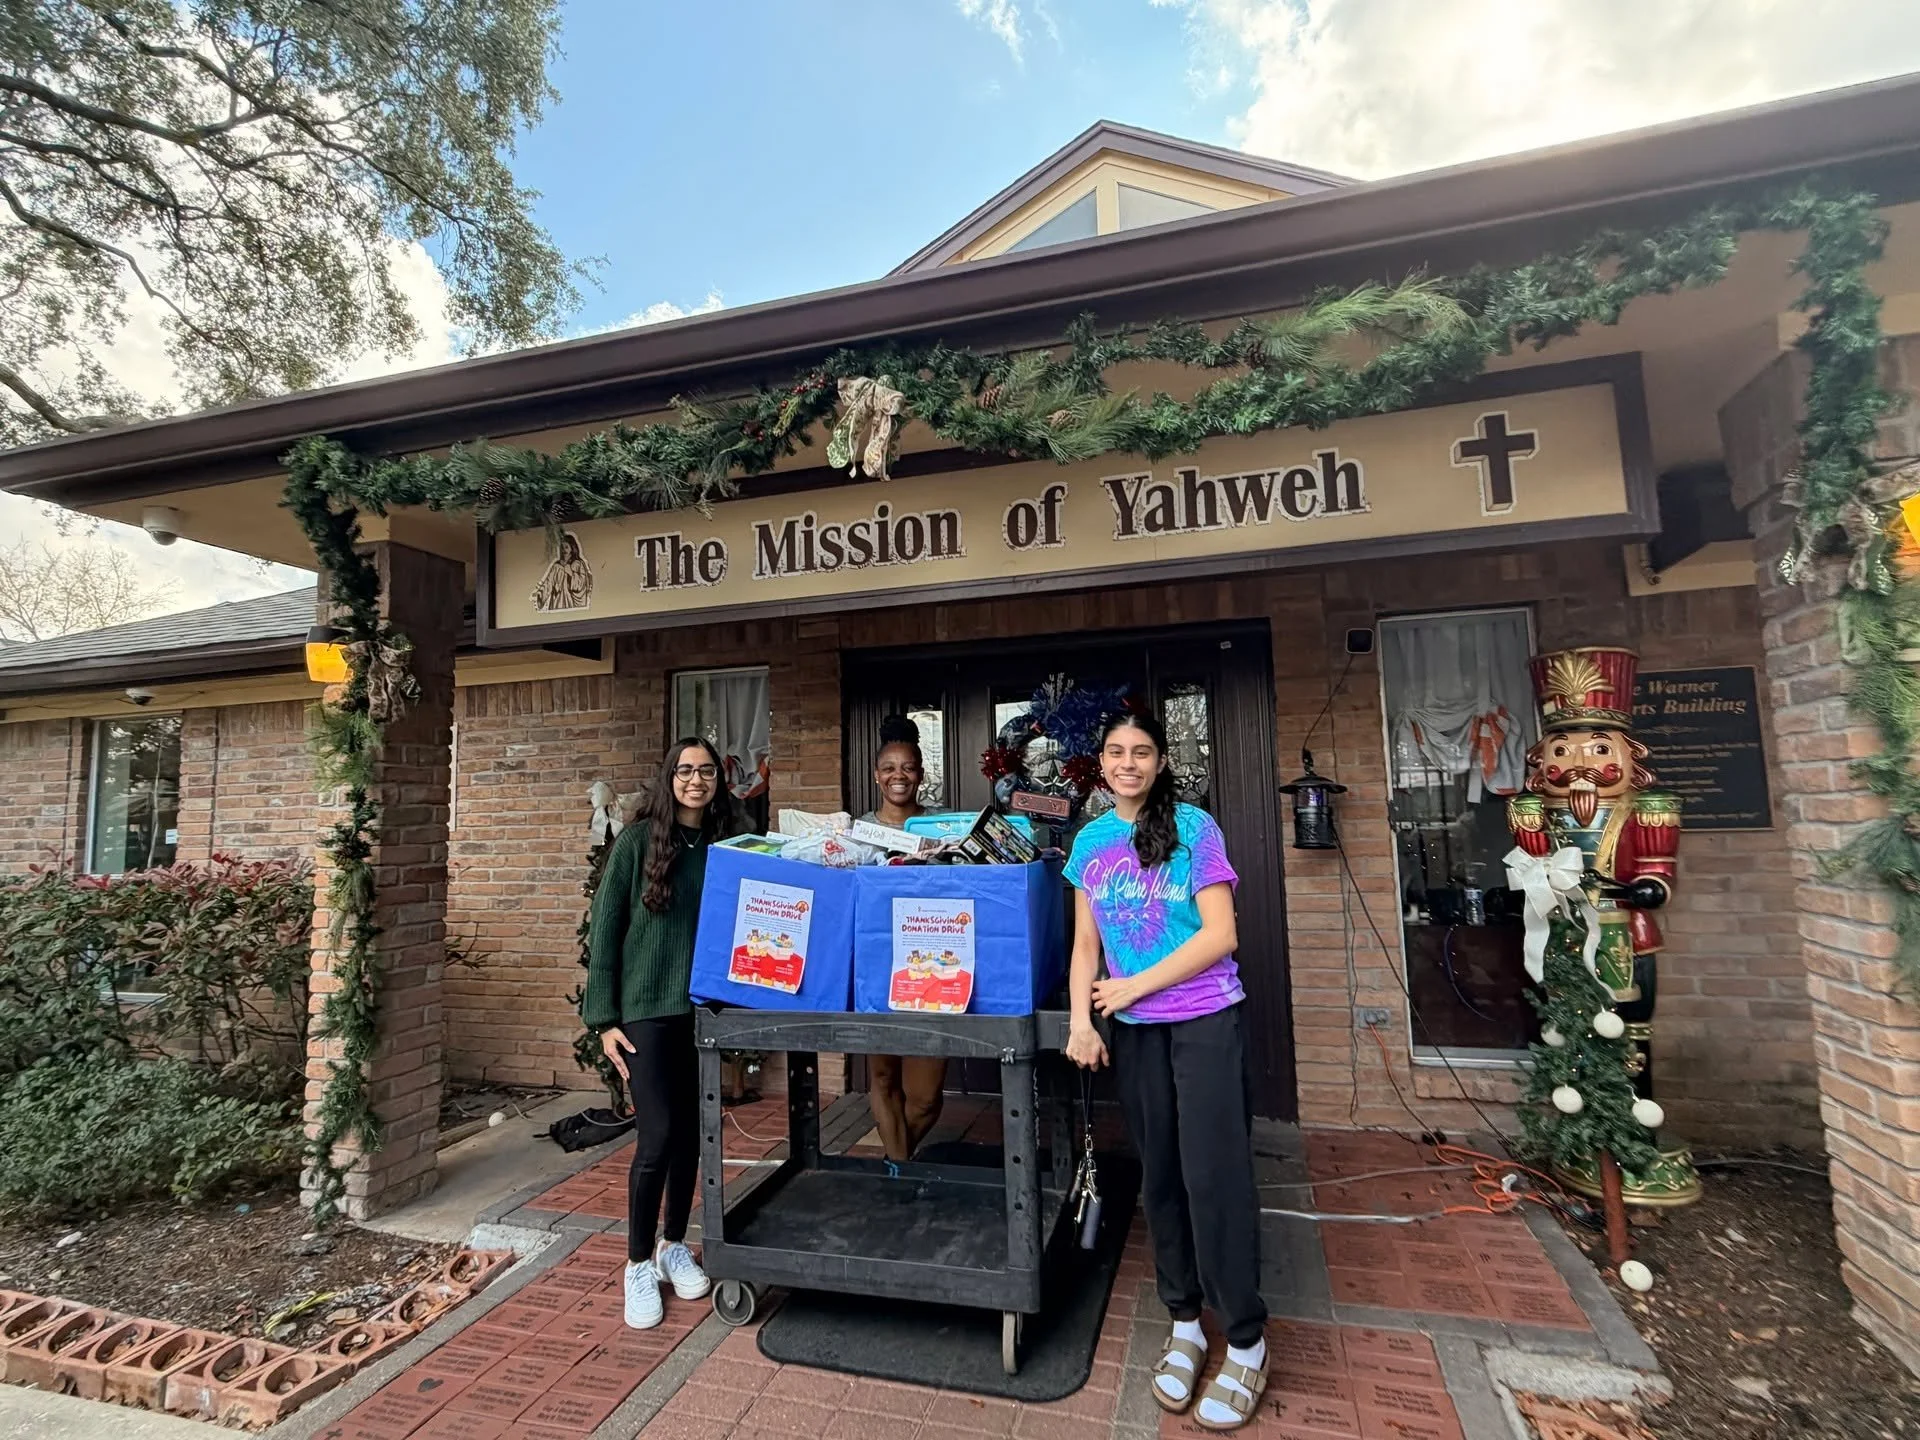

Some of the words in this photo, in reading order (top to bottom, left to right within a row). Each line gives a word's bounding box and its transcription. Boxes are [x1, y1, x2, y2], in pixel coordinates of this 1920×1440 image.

[636, 532, 727, 590] The
[753, 503, 965, 578] Mission
[1004, 483, 1067, 548] of
[1101, 450, 1370, 538] Yahweh
[1647, 680, 1720, 695] Warner
[1632, 703, 1657, 716] rts
[1663, 697, 1747, 715] Building
[1110, 856, 1147, 911] Padre
[1143, 860, 1192, 908] Island
